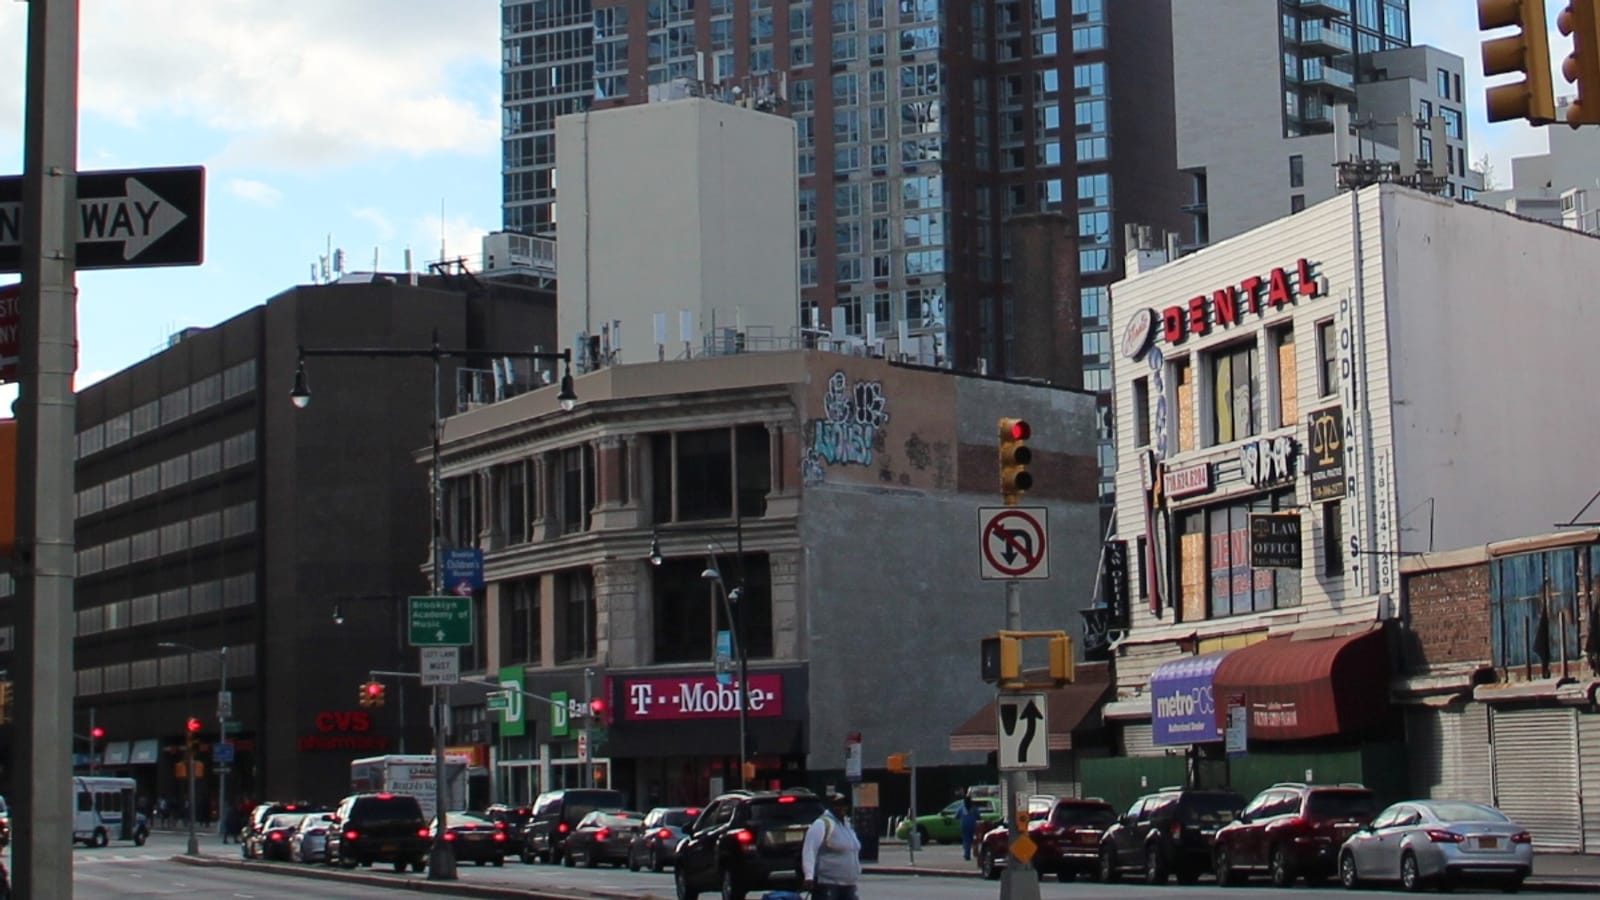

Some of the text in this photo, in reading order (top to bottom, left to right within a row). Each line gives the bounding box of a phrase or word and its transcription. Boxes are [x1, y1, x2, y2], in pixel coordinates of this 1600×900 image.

[81, 201, 160, 238] WAY
[1162, 258, 1317, 343] DENTAL
[1340, 299, 1360, 588] PODIATRIST
[1271, 521, 1298, 535] LAW
[1253, 543, 1297, 554] OFFICE
[412, 601, 458, 610] Brooklyn
[412, 610, 468, 620] Academy of
[430, 662, 450, 670] MUST
[315, 711, 371, 732] CVS
